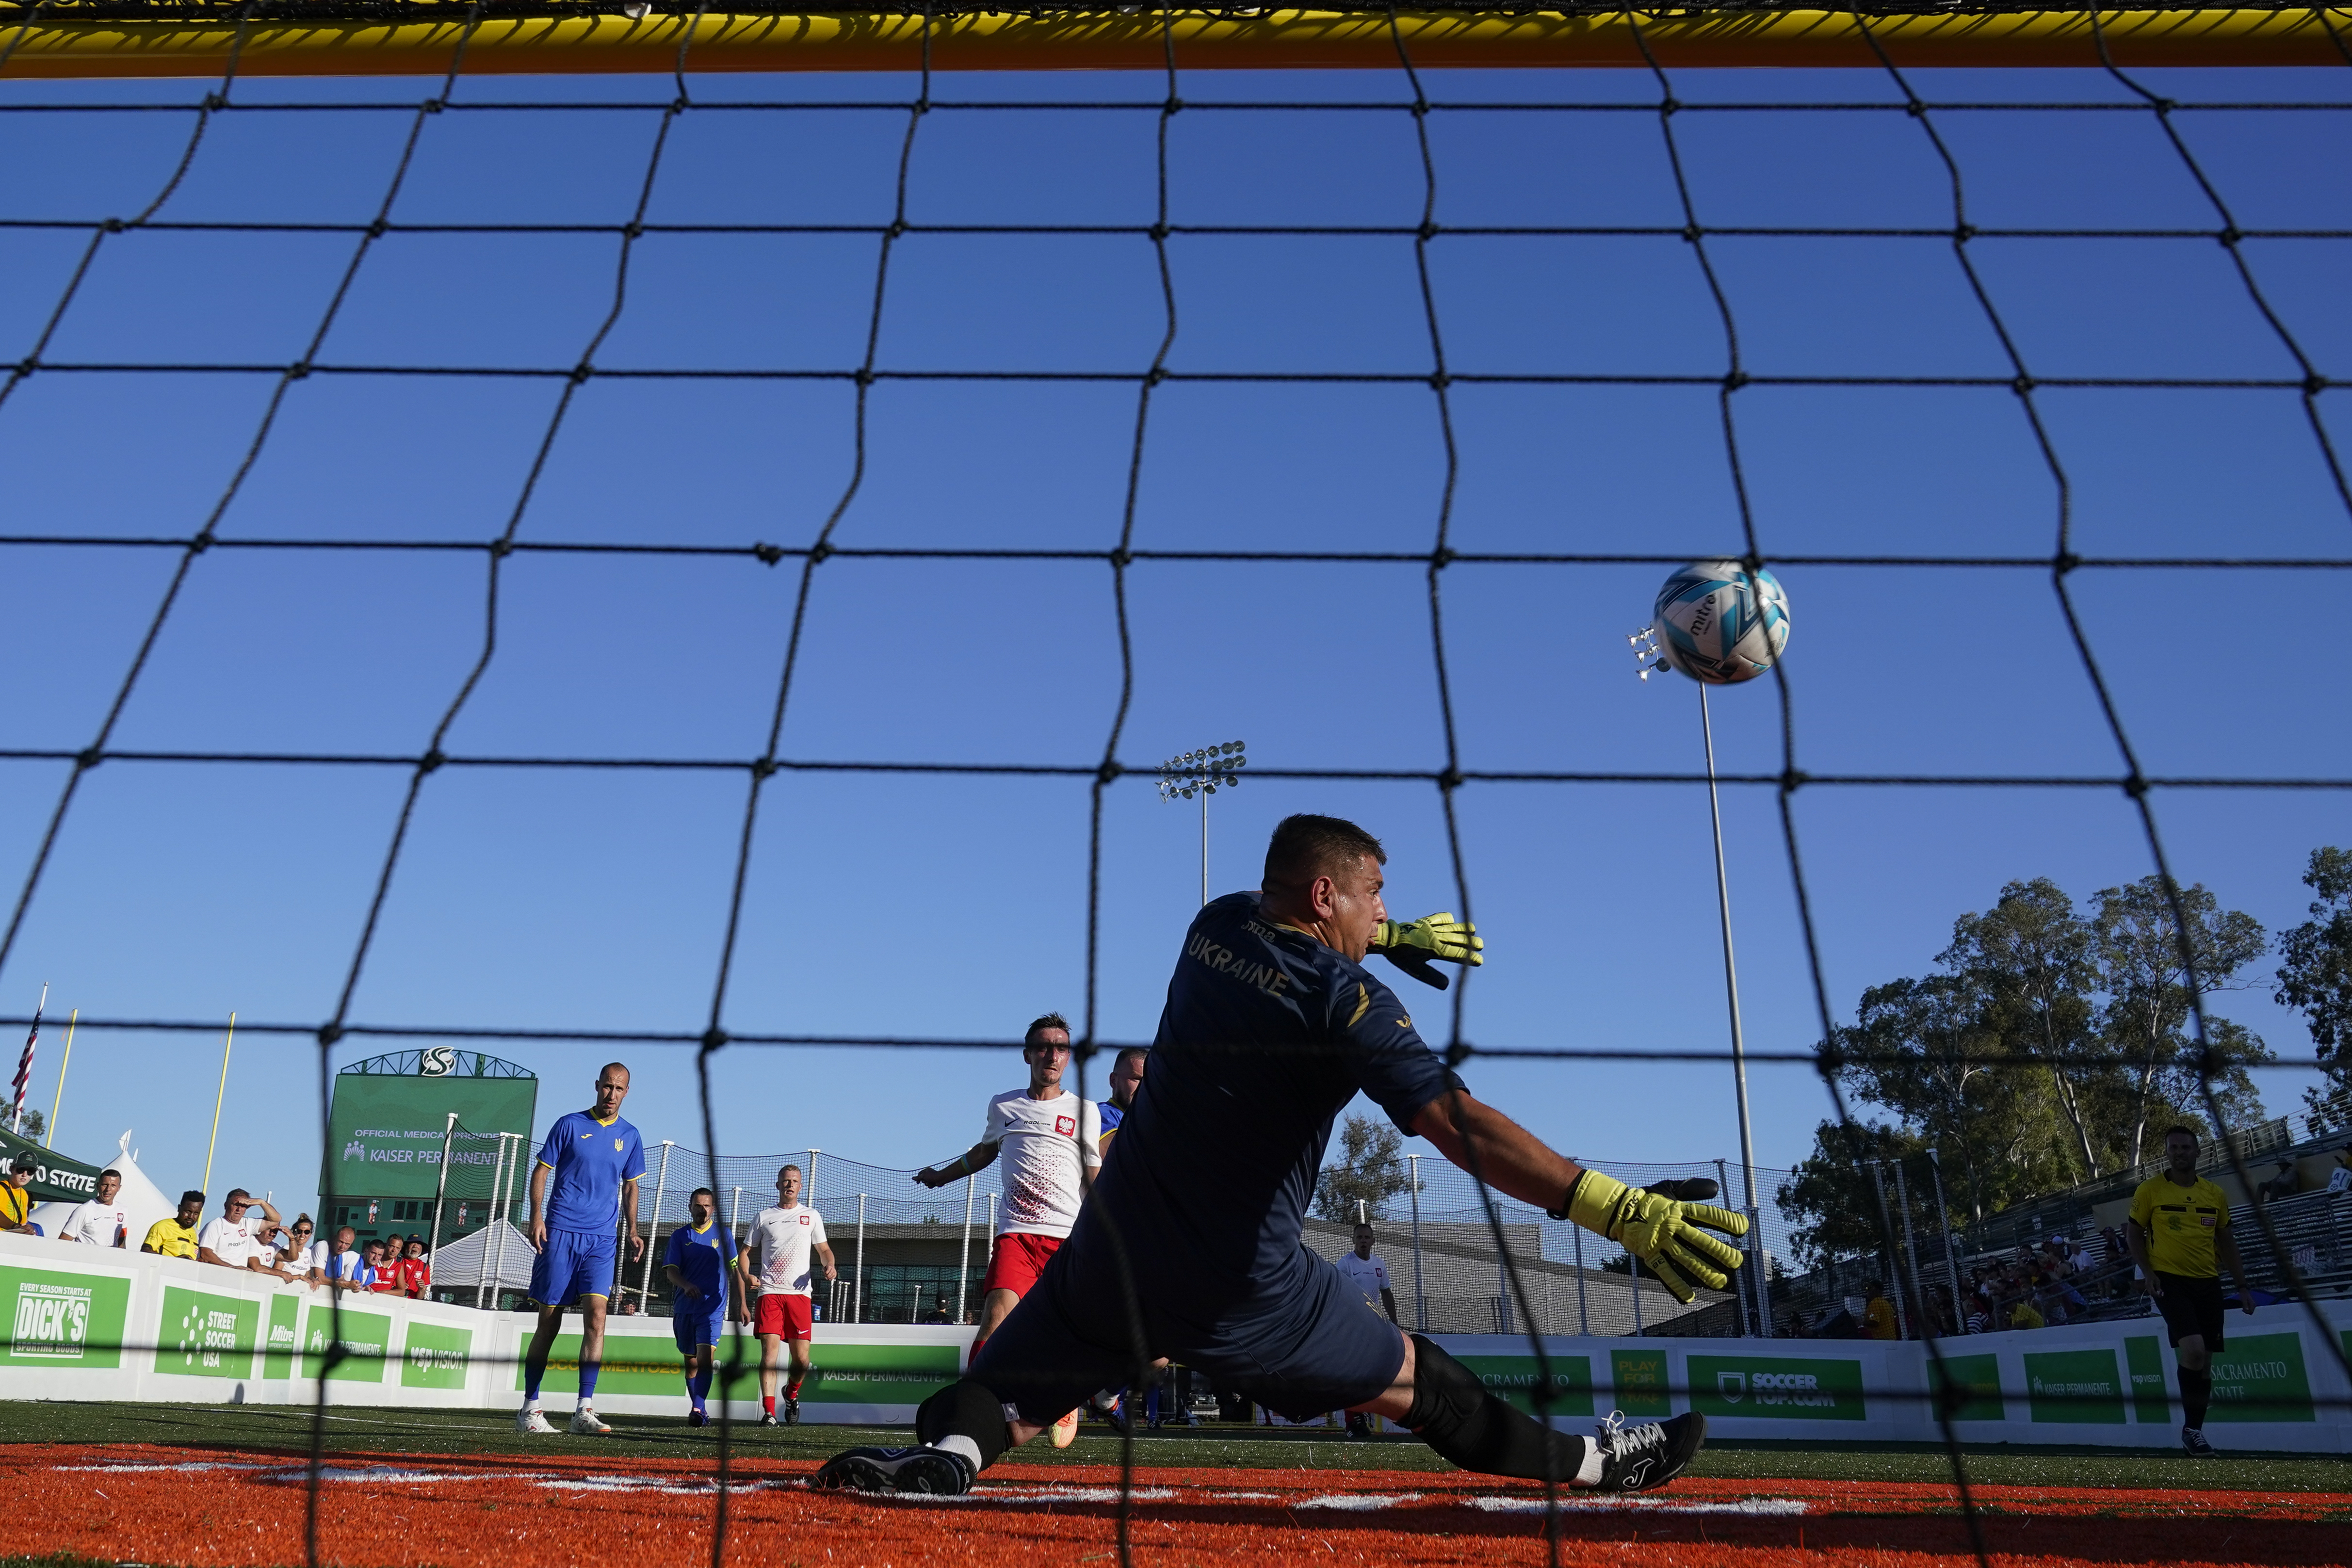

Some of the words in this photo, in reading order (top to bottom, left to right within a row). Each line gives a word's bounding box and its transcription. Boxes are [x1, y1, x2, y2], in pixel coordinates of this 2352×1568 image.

[1690, 593, 1717, 636] mitre
[1188, 933, 1290, 997] UKRAINE
[355, 1129, 401, 1138] OFFICIAL
[370, 1149, 414, 1163] KAISER
[49, 1169, 97, 1193] STATE
[20, 1283, 40, 1292] EVERY
[40, 1285, 63, 1294] SEASON
[63, 1287, 84, 1295] STARTS
[16, 1295, 86, 1342] DICK'S
[208, 1310, 236, 1330] STREET
[16, 1342, 53, 1352] SPORTING
[55, 1343, 81, 1353] GOODS
[205, 1330, 236, 1349] SOCCER
[203, 1351, 220, 1367] USA
[546, 1359, 681, 1374] OCCMENTO23
[1619, 1361, 1657, 1372] PLAY
[823, 1370, 861, 1381] KAISER
[864, 1371, 941, 1383] PERMANENTE
[1623, 1373, 1655, 1384] FOR
[2210, 1361, 2287, 1381] SACRAMENTO
[1752, 1373, 1818, 1390] SOCCER
[2044, 1383, 2065, 1396] KAISER
[2066, 1382, 2112, 1396] PERMANENTE
[2214, 1386, 2245, 1402] STATE
